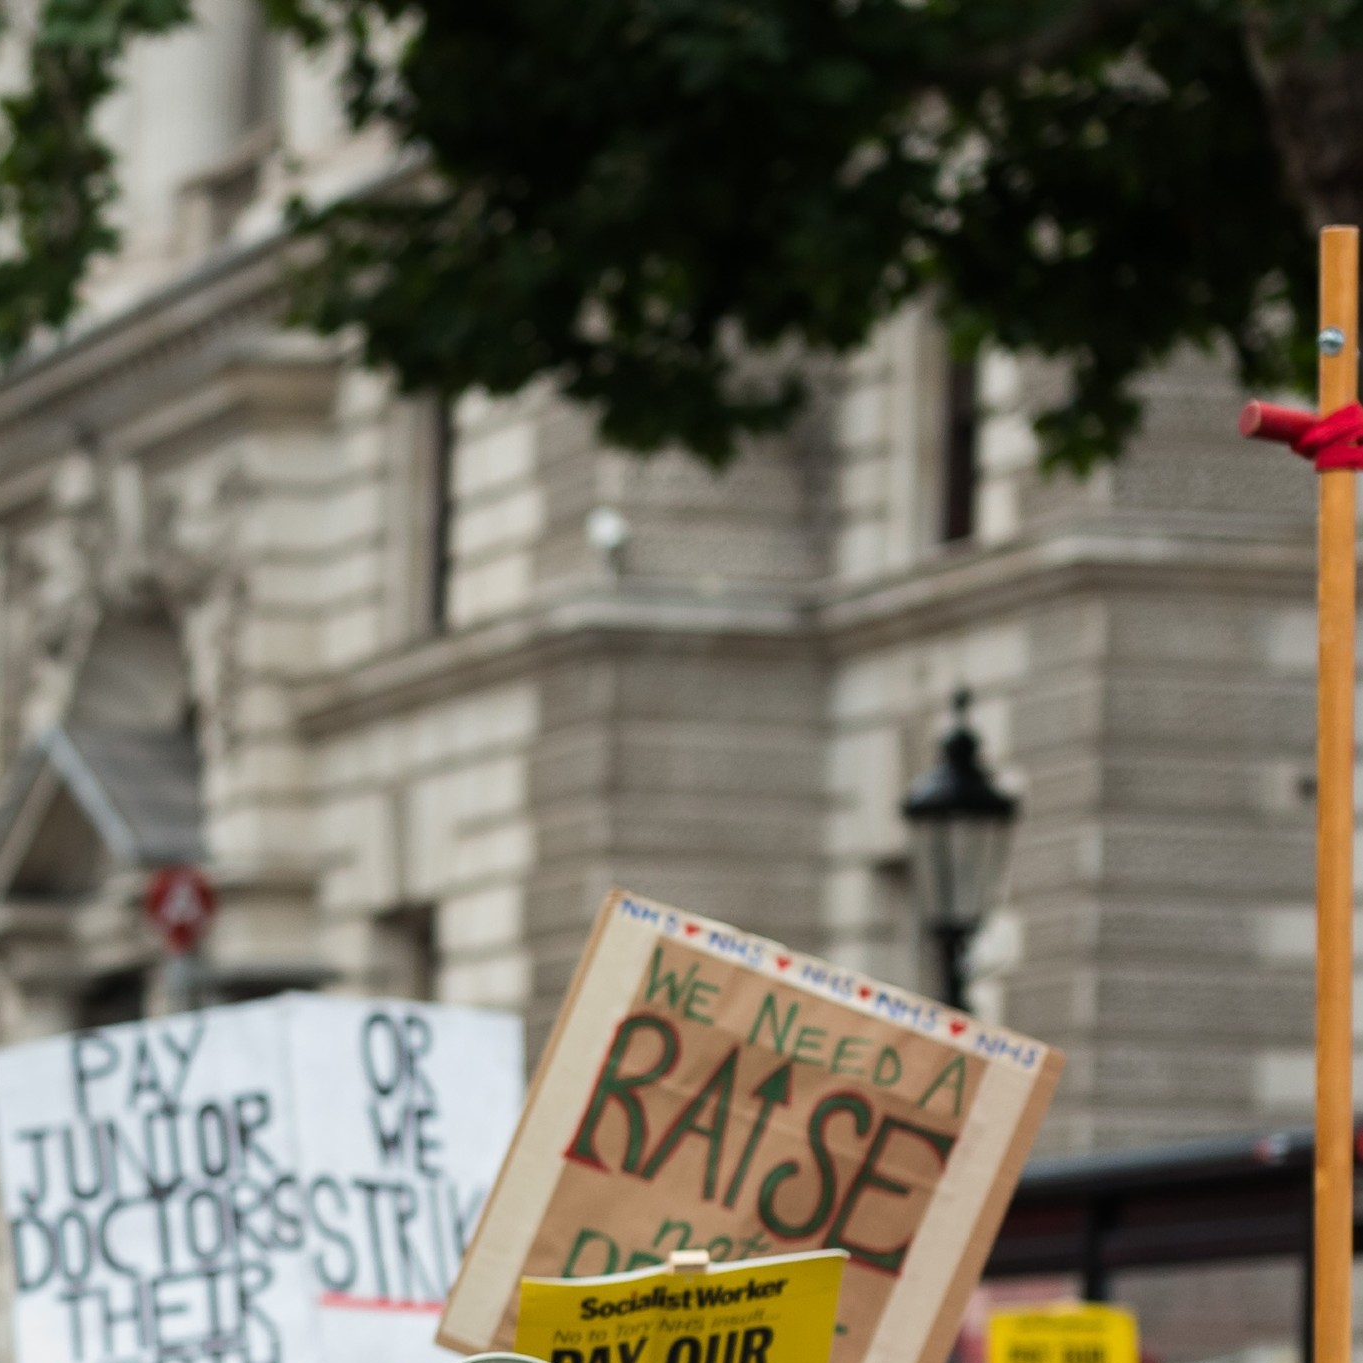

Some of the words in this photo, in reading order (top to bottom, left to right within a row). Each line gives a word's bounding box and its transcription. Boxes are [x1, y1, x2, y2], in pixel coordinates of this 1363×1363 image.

[645, 945, 721, 1025] WE
[747, 993, 902, 1087] NEED
[915, 1054, 969, 1117] A
[708, 930, 767, 969] NHS
[800, 963, 855, 998] NHS
[875, 990, 940, 1032] NHS
[974, 1031, 1041, 1070] NHS
[72, 1016, 206, 1116] PAY
[360, 1012, 437, 1107] OR
[15, 1093, 276, 1212] JUNIOR
[368, 1102, 443, 1178] WE
[11, 1174, 303, 1292] DOCTORS
[59, 1260, 280, 1362] THEIR
[552, 1328, 582, 1344] No
[587, 1325, 607, 1342] to
[656, 1315, 705, 1334] NHS
[579, 1286, 699, 1321] Socialist
[695, 1277, 788, 1308] Worker
